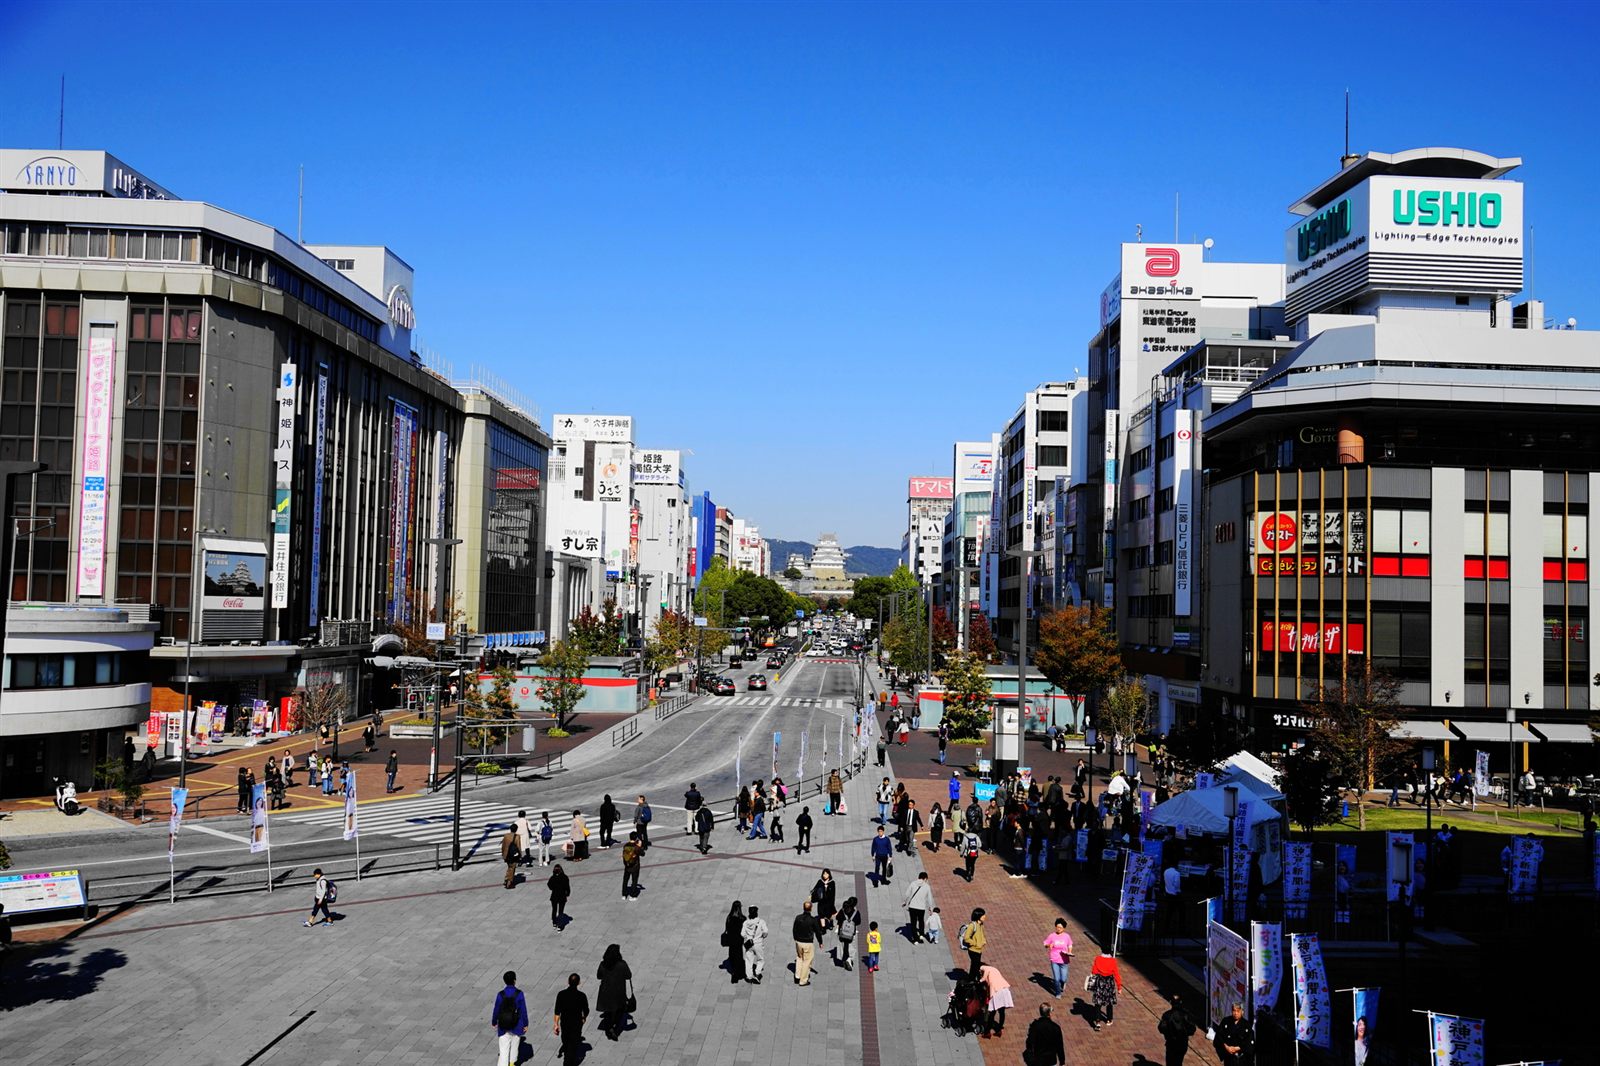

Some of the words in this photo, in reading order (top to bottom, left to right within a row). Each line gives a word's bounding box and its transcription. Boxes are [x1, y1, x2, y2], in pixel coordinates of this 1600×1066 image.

[25, 165, 76, 186] SANYO
[1393, 189, 1502, 229] USHIO
[1297, 198, 1352, 262] USHIO
[1453, 233, 1519, 245] Technologies
[279, 398, 294, 470] 神姫バス
[643, 454, 663, 463] 姫路
[1266, 530, 1294, 540] ガスト
[1301, 513, 1344, 530] モーング
[561, 536, 599, 551] すし宗
[1176, 503, 1188, 590] 三菱UFJ信託銀行
[275, 541, 286, 602] 三井住友銀行
[1297, 941, 1321, 1040] 神戸新聞まつり
